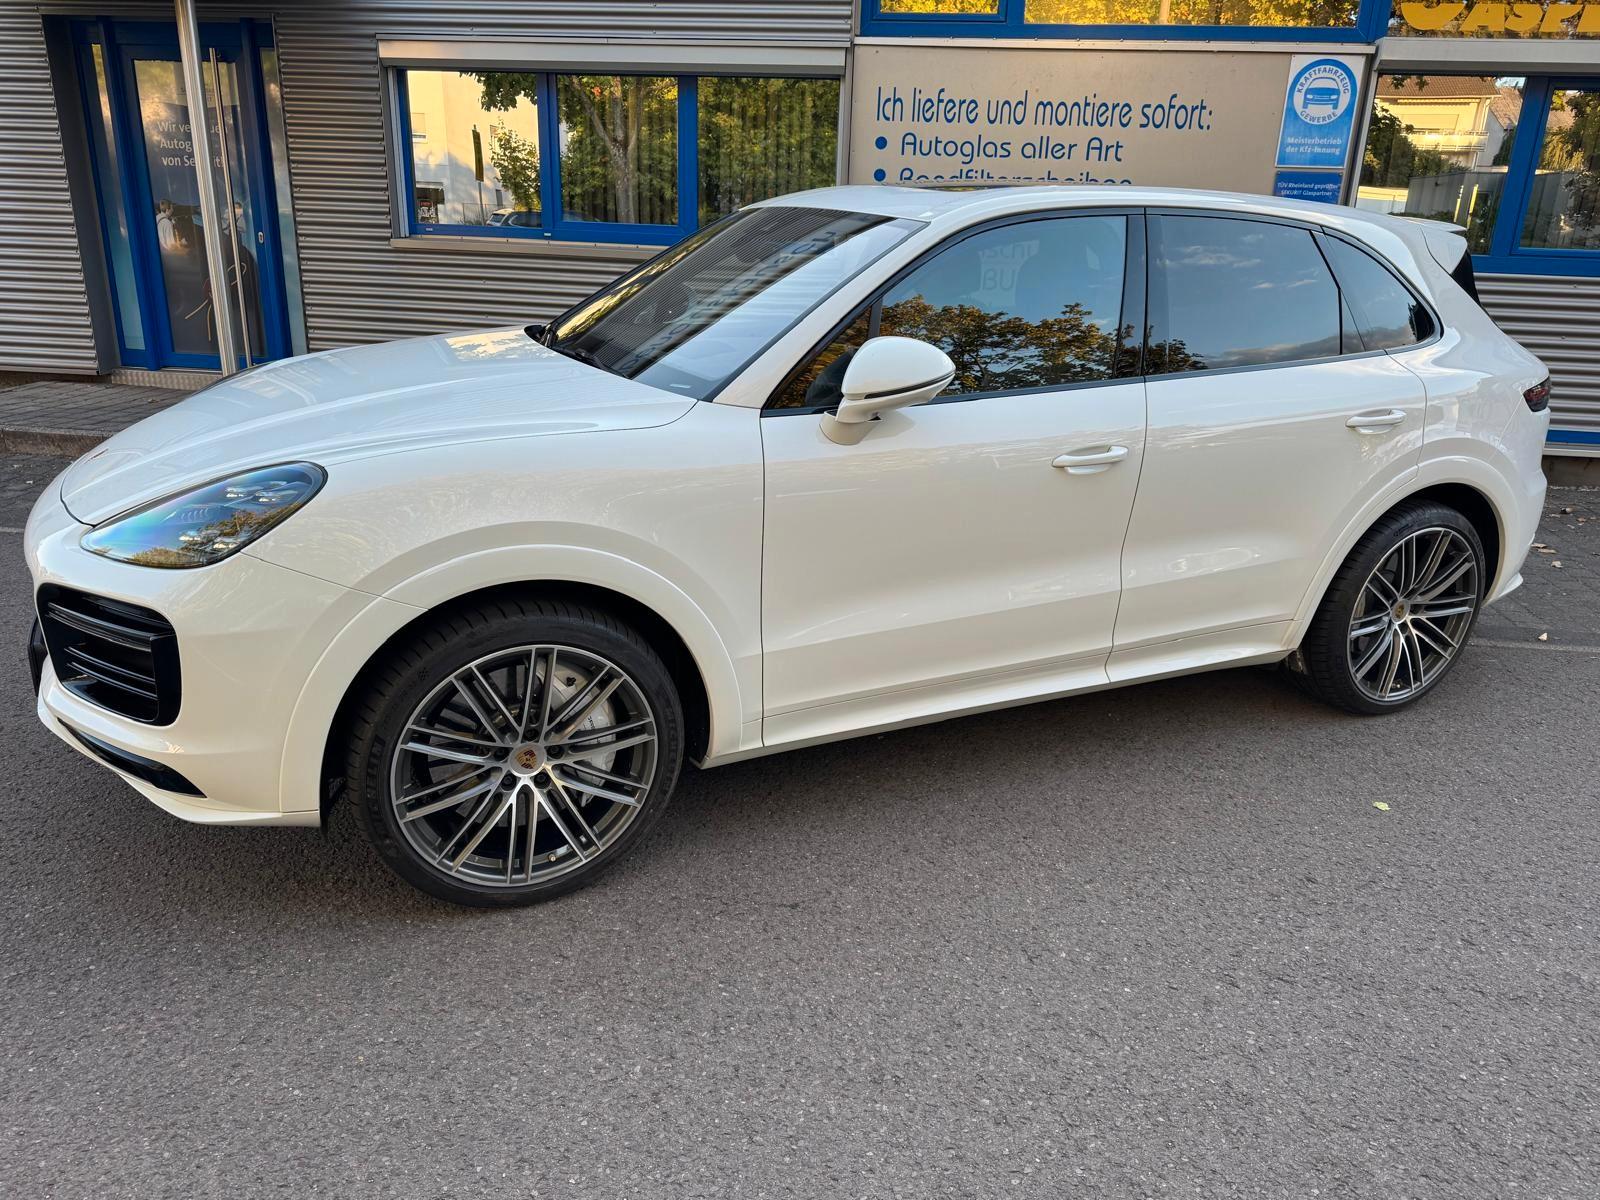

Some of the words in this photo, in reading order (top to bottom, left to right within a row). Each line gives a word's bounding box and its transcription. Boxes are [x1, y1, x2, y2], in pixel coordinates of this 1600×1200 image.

[1296, 67, 1350, 94] KRAFTFAHRZEUG
[876, 86, 903, 122] Ich
[912, 88, 979, 124] liefere
[987, 90, 1028, 125] und
[1034, 93, 1133, 128] montiere
[1139, 94, 1213, 131] sofort:
[1300, 110, 1338, 123] GEWERBE
[901, 132, 1011, 165] Autoglas
[1021, 136, 1078, 161] aller
[1086, 137, 1124, 162] Art
[1287, 136, 1342, 145] Meisterbetrieb
[161, 157, 181, 166] von
